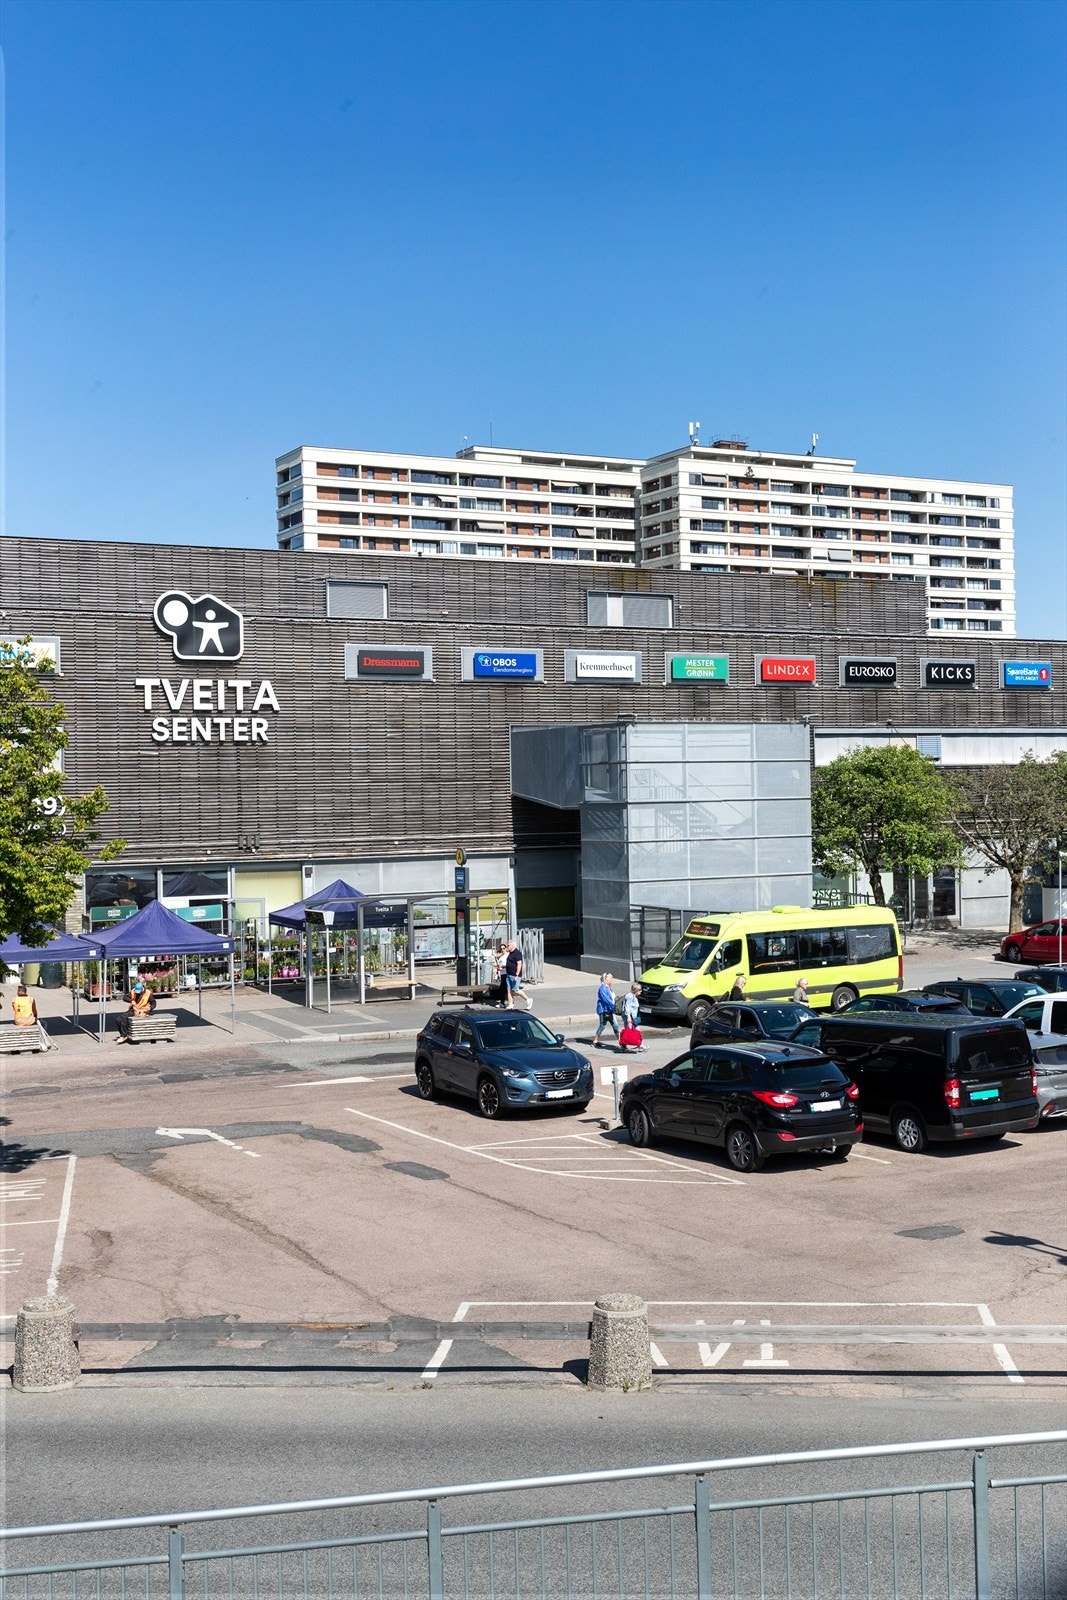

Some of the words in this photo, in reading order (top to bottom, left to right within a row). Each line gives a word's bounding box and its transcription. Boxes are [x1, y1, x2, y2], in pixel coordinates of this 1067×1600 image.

[363, 657, 420, 668] Dressmann
[492, 658, 517, 667] OBOS
[580, 662, 633, 672] Kremmerhuset
[685, 659, 714, 667] MESTER
[686, 669, 714, 677] GRØNN
[767, 664, 810, 676] LINDEX
[849, 666, 895, 677] EUROSKO
[931, 667, 972, 679] KICKS
[1007, 668, 1039, 676] SpareBank
[135, 678, 281, 712] TVEITA
[151, 717, 270, 742] SENTER
